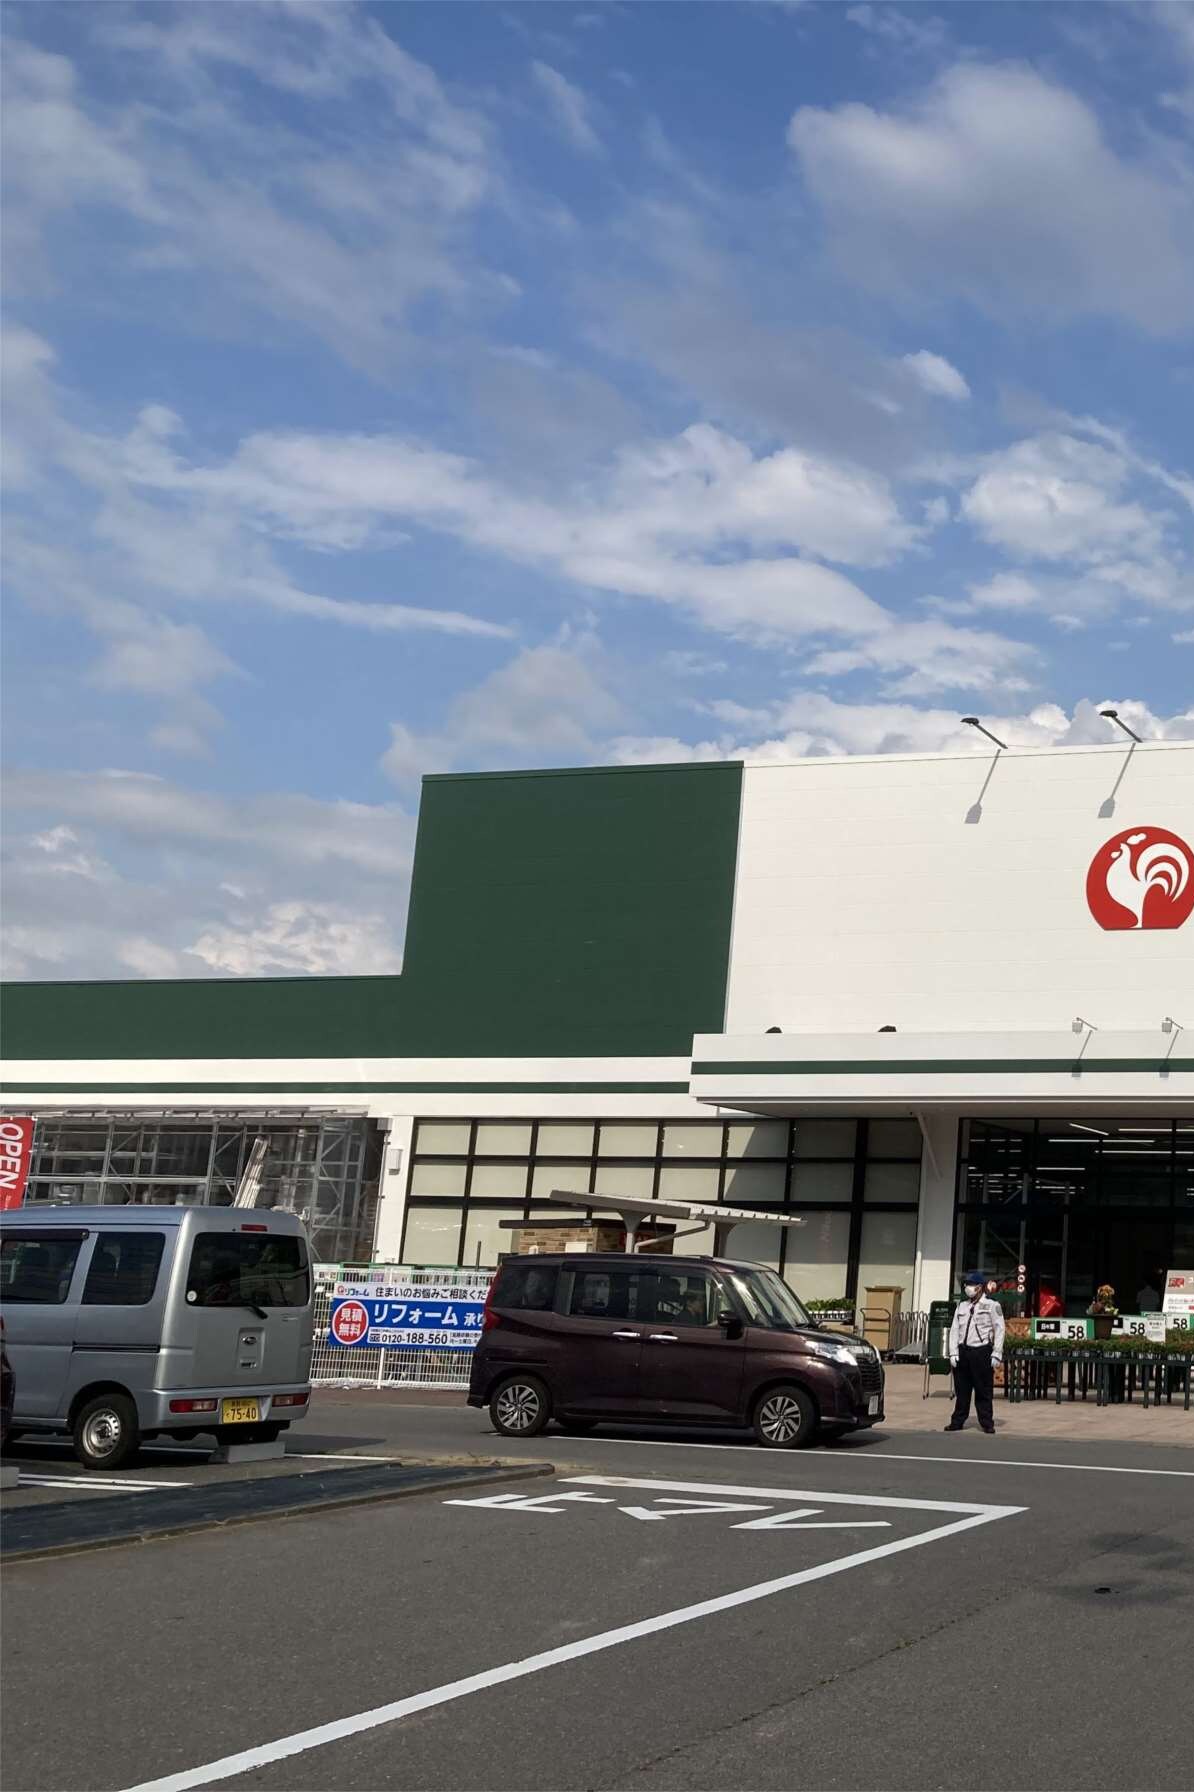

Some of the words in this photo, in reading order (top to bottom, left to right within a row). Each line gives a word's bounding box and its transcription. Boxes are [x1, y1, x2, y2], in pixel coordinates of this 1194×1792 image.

[0, 1123, 24, 1190] OPEN
[340, 1308, 363, 1322] 見積
[374, 1303, 458, 1326] リフォーム
[338, 1323, 362, 1337] 無料
[1130, 1322, 1146, 1335] 58
[1173, 1318, 1188, 1330] 58
[381, 1331, 448, 1345] 0120-188-560
[1068, 1325, 1085, 1339] 58
